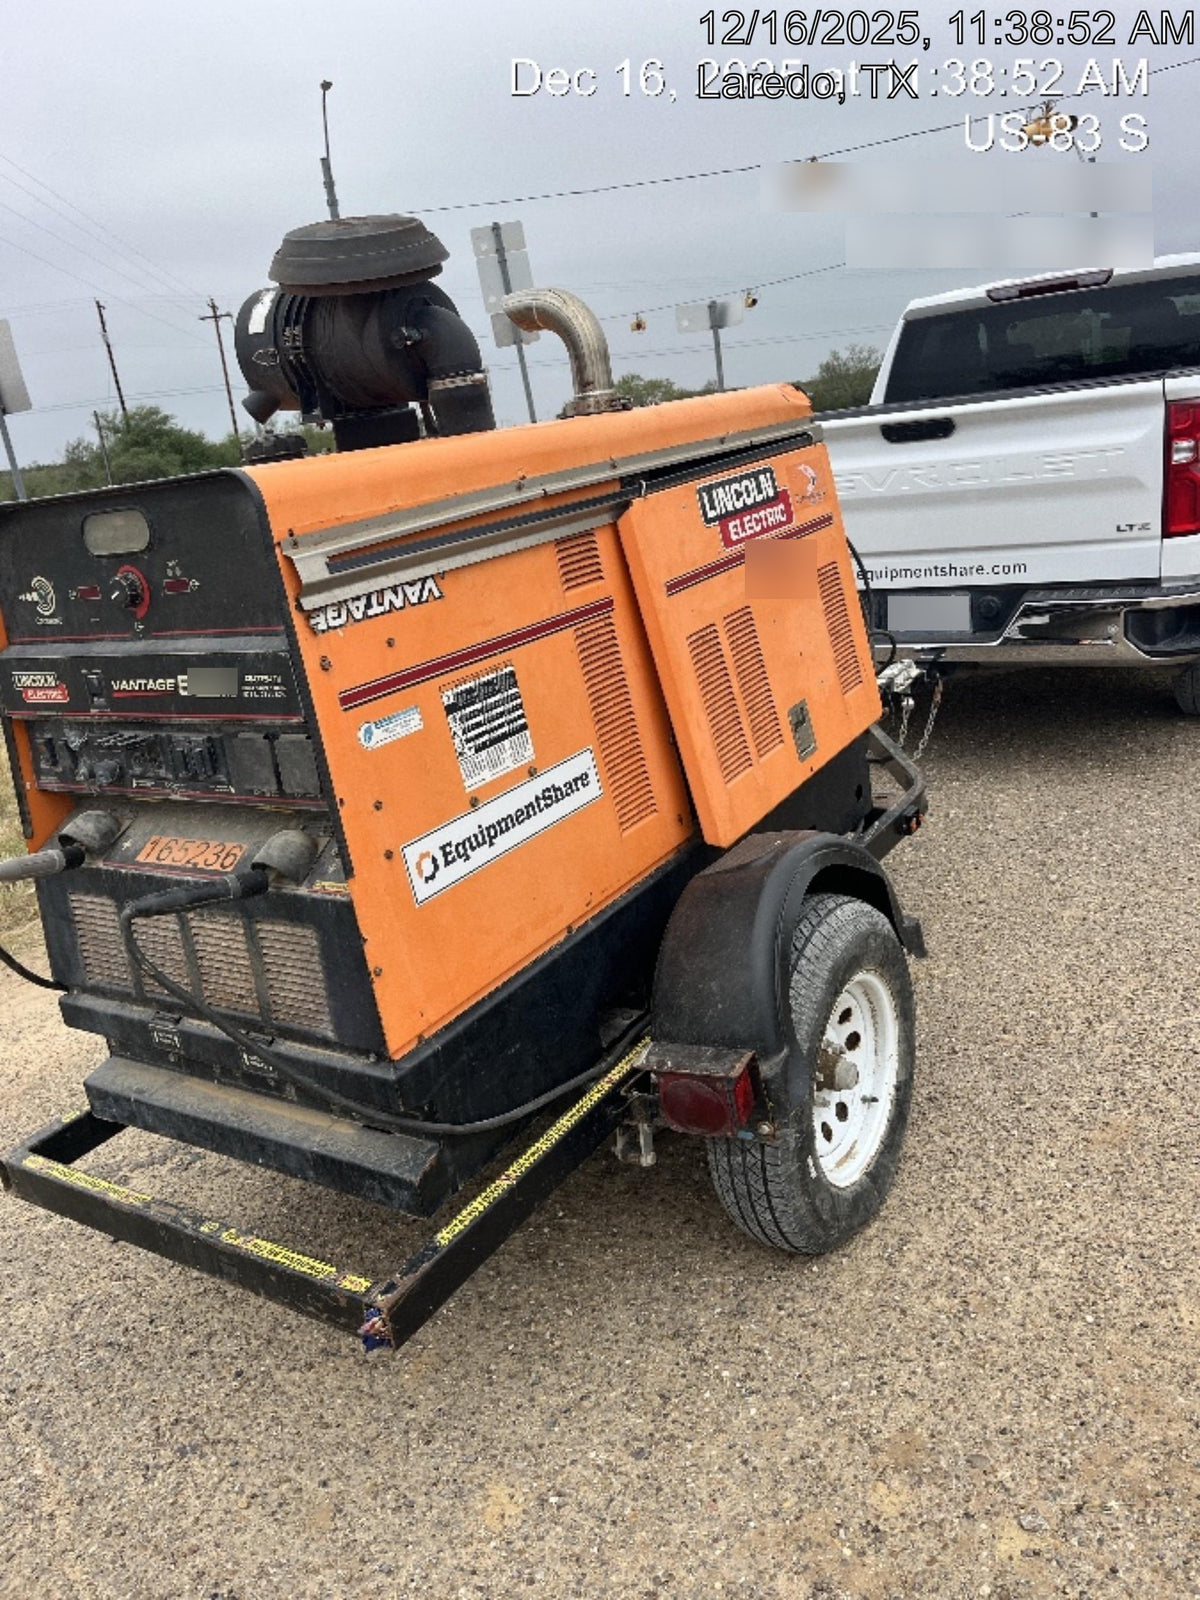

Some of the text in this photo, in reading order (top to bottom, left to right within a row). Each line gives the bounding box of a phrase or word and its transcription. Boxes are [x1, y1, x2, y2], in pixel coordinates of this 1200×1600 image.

[701, 472, 775, 519] LINCOLN
[728, 502, 788, 542] ELECTRIC
[856, 561, 1028, 583] equipmentshare.com
[111, 678, 176, 691] VANTAGE
[439, 771, 591, 869] EquipmentShare
[143, 836, 243, 870] 165236
